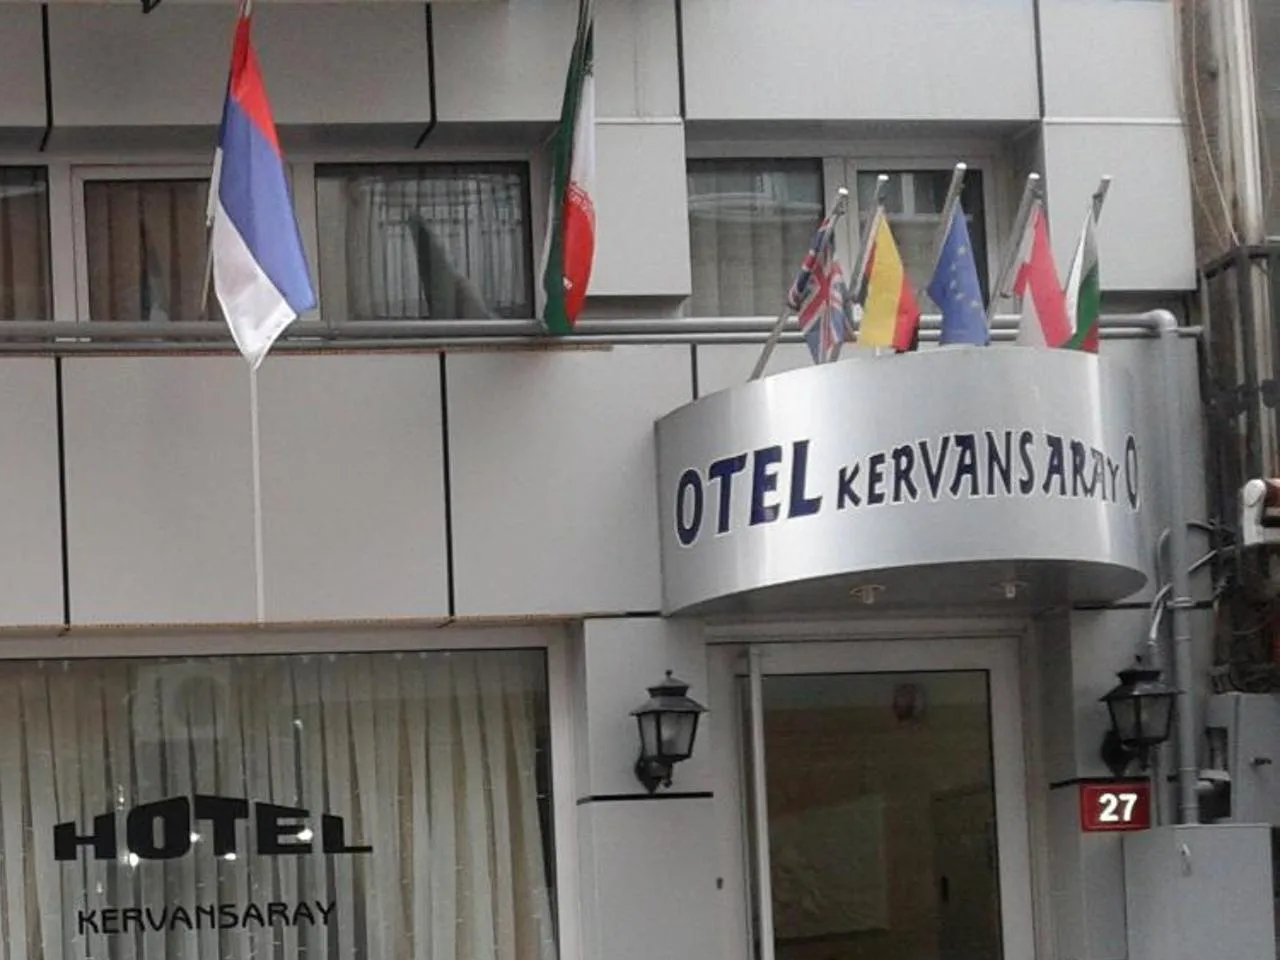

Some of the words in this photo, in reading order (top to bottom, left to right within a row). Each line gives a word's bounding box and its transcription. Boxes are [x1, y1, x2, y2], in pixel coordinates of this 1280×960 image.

[675, 439, 823, 547] OTEL
[836, 428, 1120, 511] KERVANSARAY
[53, 793, 373, 861] HOTEL
[1098, 792, 1138, 823] 27
[78, 899, 337, 936] KERVANSARAY
